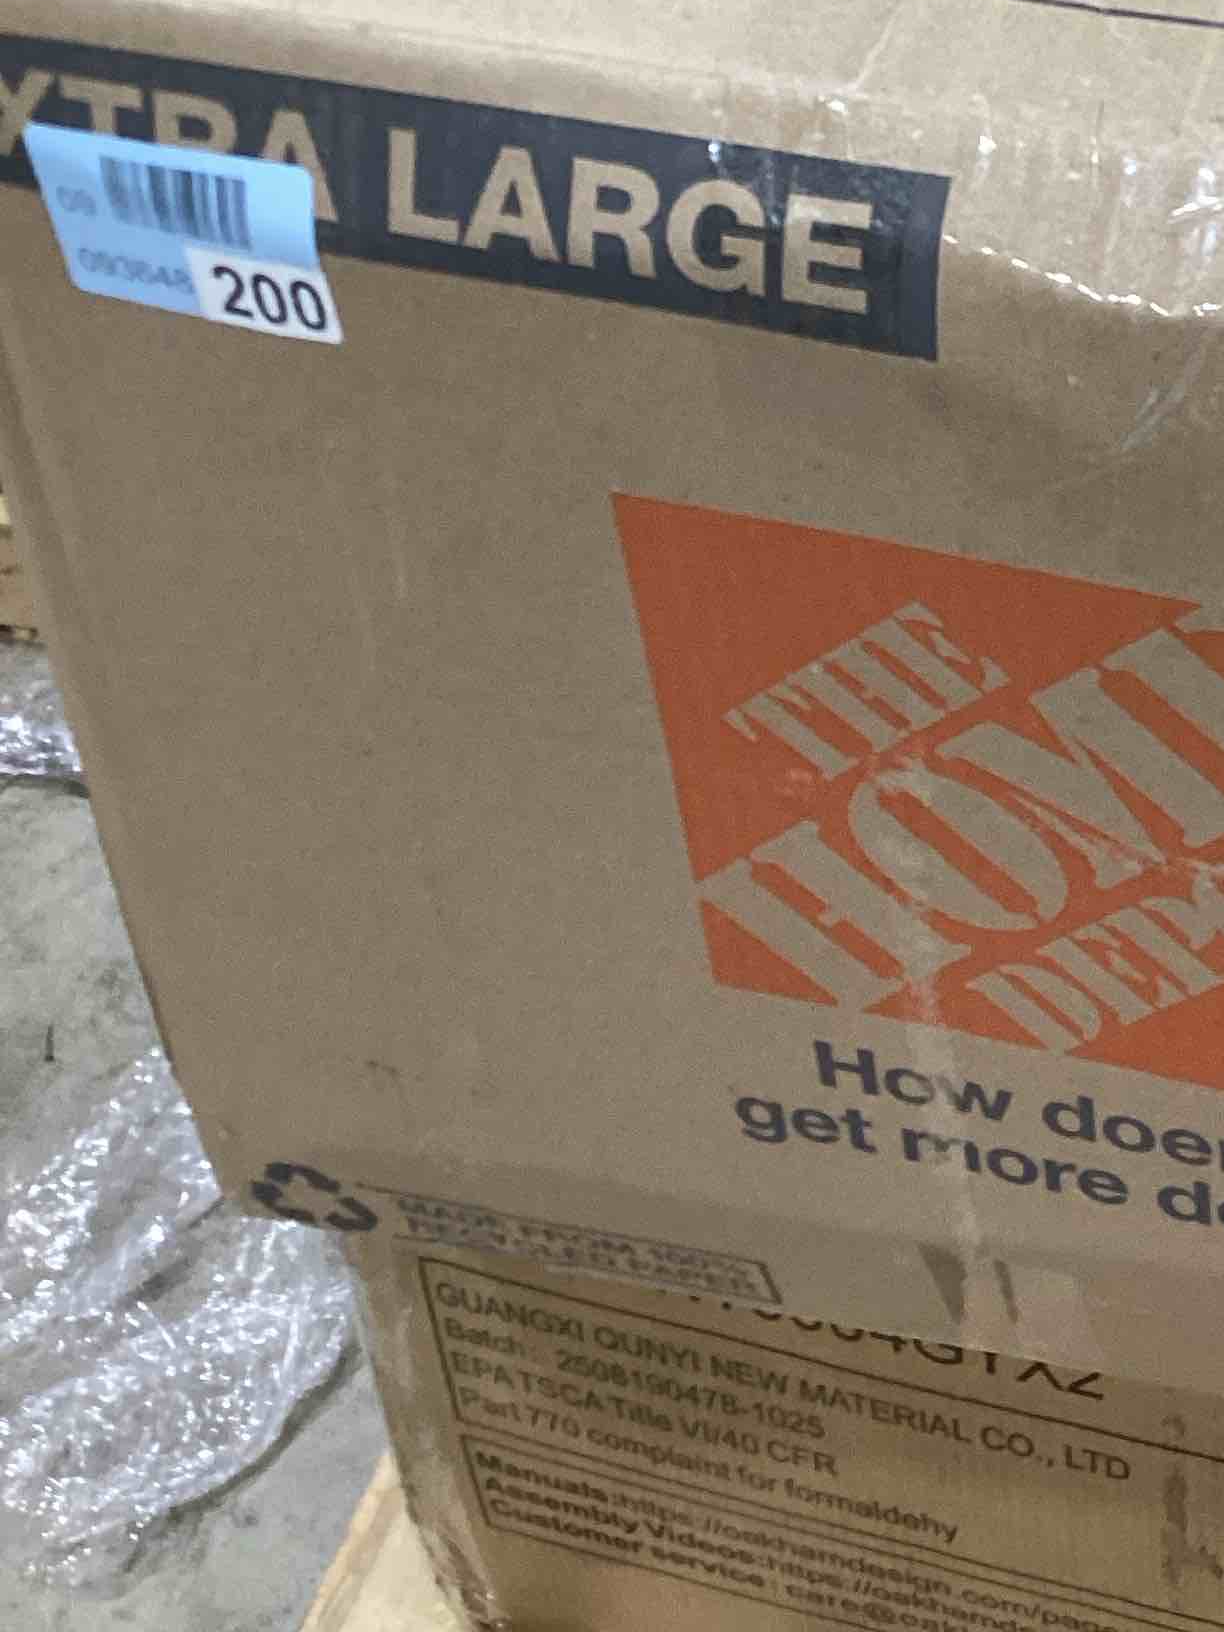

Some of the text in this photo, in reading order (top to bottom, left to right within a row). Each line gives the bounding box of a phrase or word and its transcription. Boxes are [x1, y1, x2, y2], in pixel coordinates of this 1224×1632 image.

[387, 128, 874, 316] LARGE
[213, 265, 327, 331] 200
[721, 599, 1010, 782] THE
[812, 1040, 1012, 1121] How
[735, 1095, 878, 1155] get
[902, 1128, 1130, 1205] more
[436, 1281, 585, 1343] GUANGXI
[709, 1355, 789, 1395] NEW
[800, 1379, 971, 1444] MATERIAL
[1064, 1445, 1131, 1480] LTD
[449, 1352, 513, 1387] EPA
[517, 1371, 600, 1410] TSCA
[767, 1440, 839, 1477] CFR
[737, 1465, 777, 1493] for
